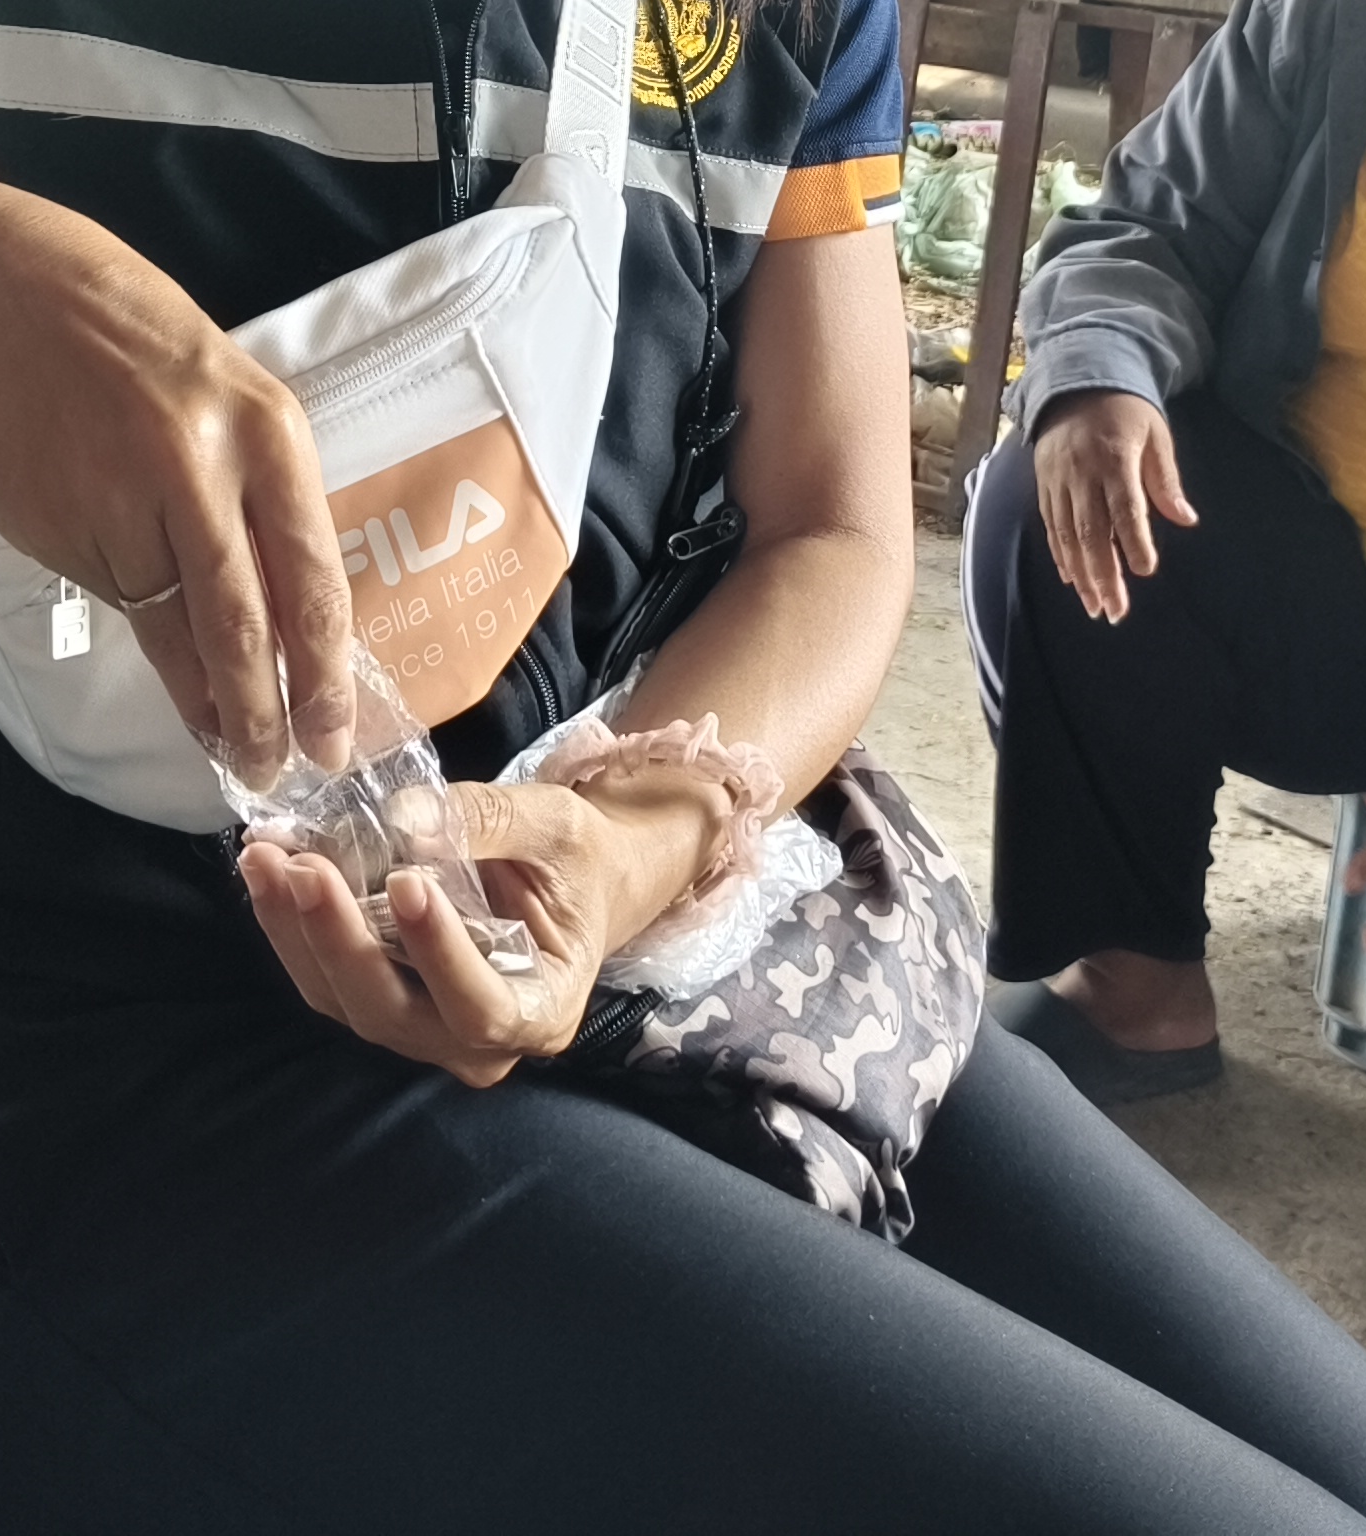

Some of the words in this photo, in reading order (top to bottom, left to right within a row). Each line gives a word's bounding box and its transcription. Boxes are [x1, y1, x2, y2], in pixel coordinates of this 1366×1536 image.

[338, 478, 506, 586] FILA
[351, 596, 433, 649] iella
[440, 547, 524, 608] Italia
[384, 642, 444, 683] nce
[455, 586, 537, 649] 1911
